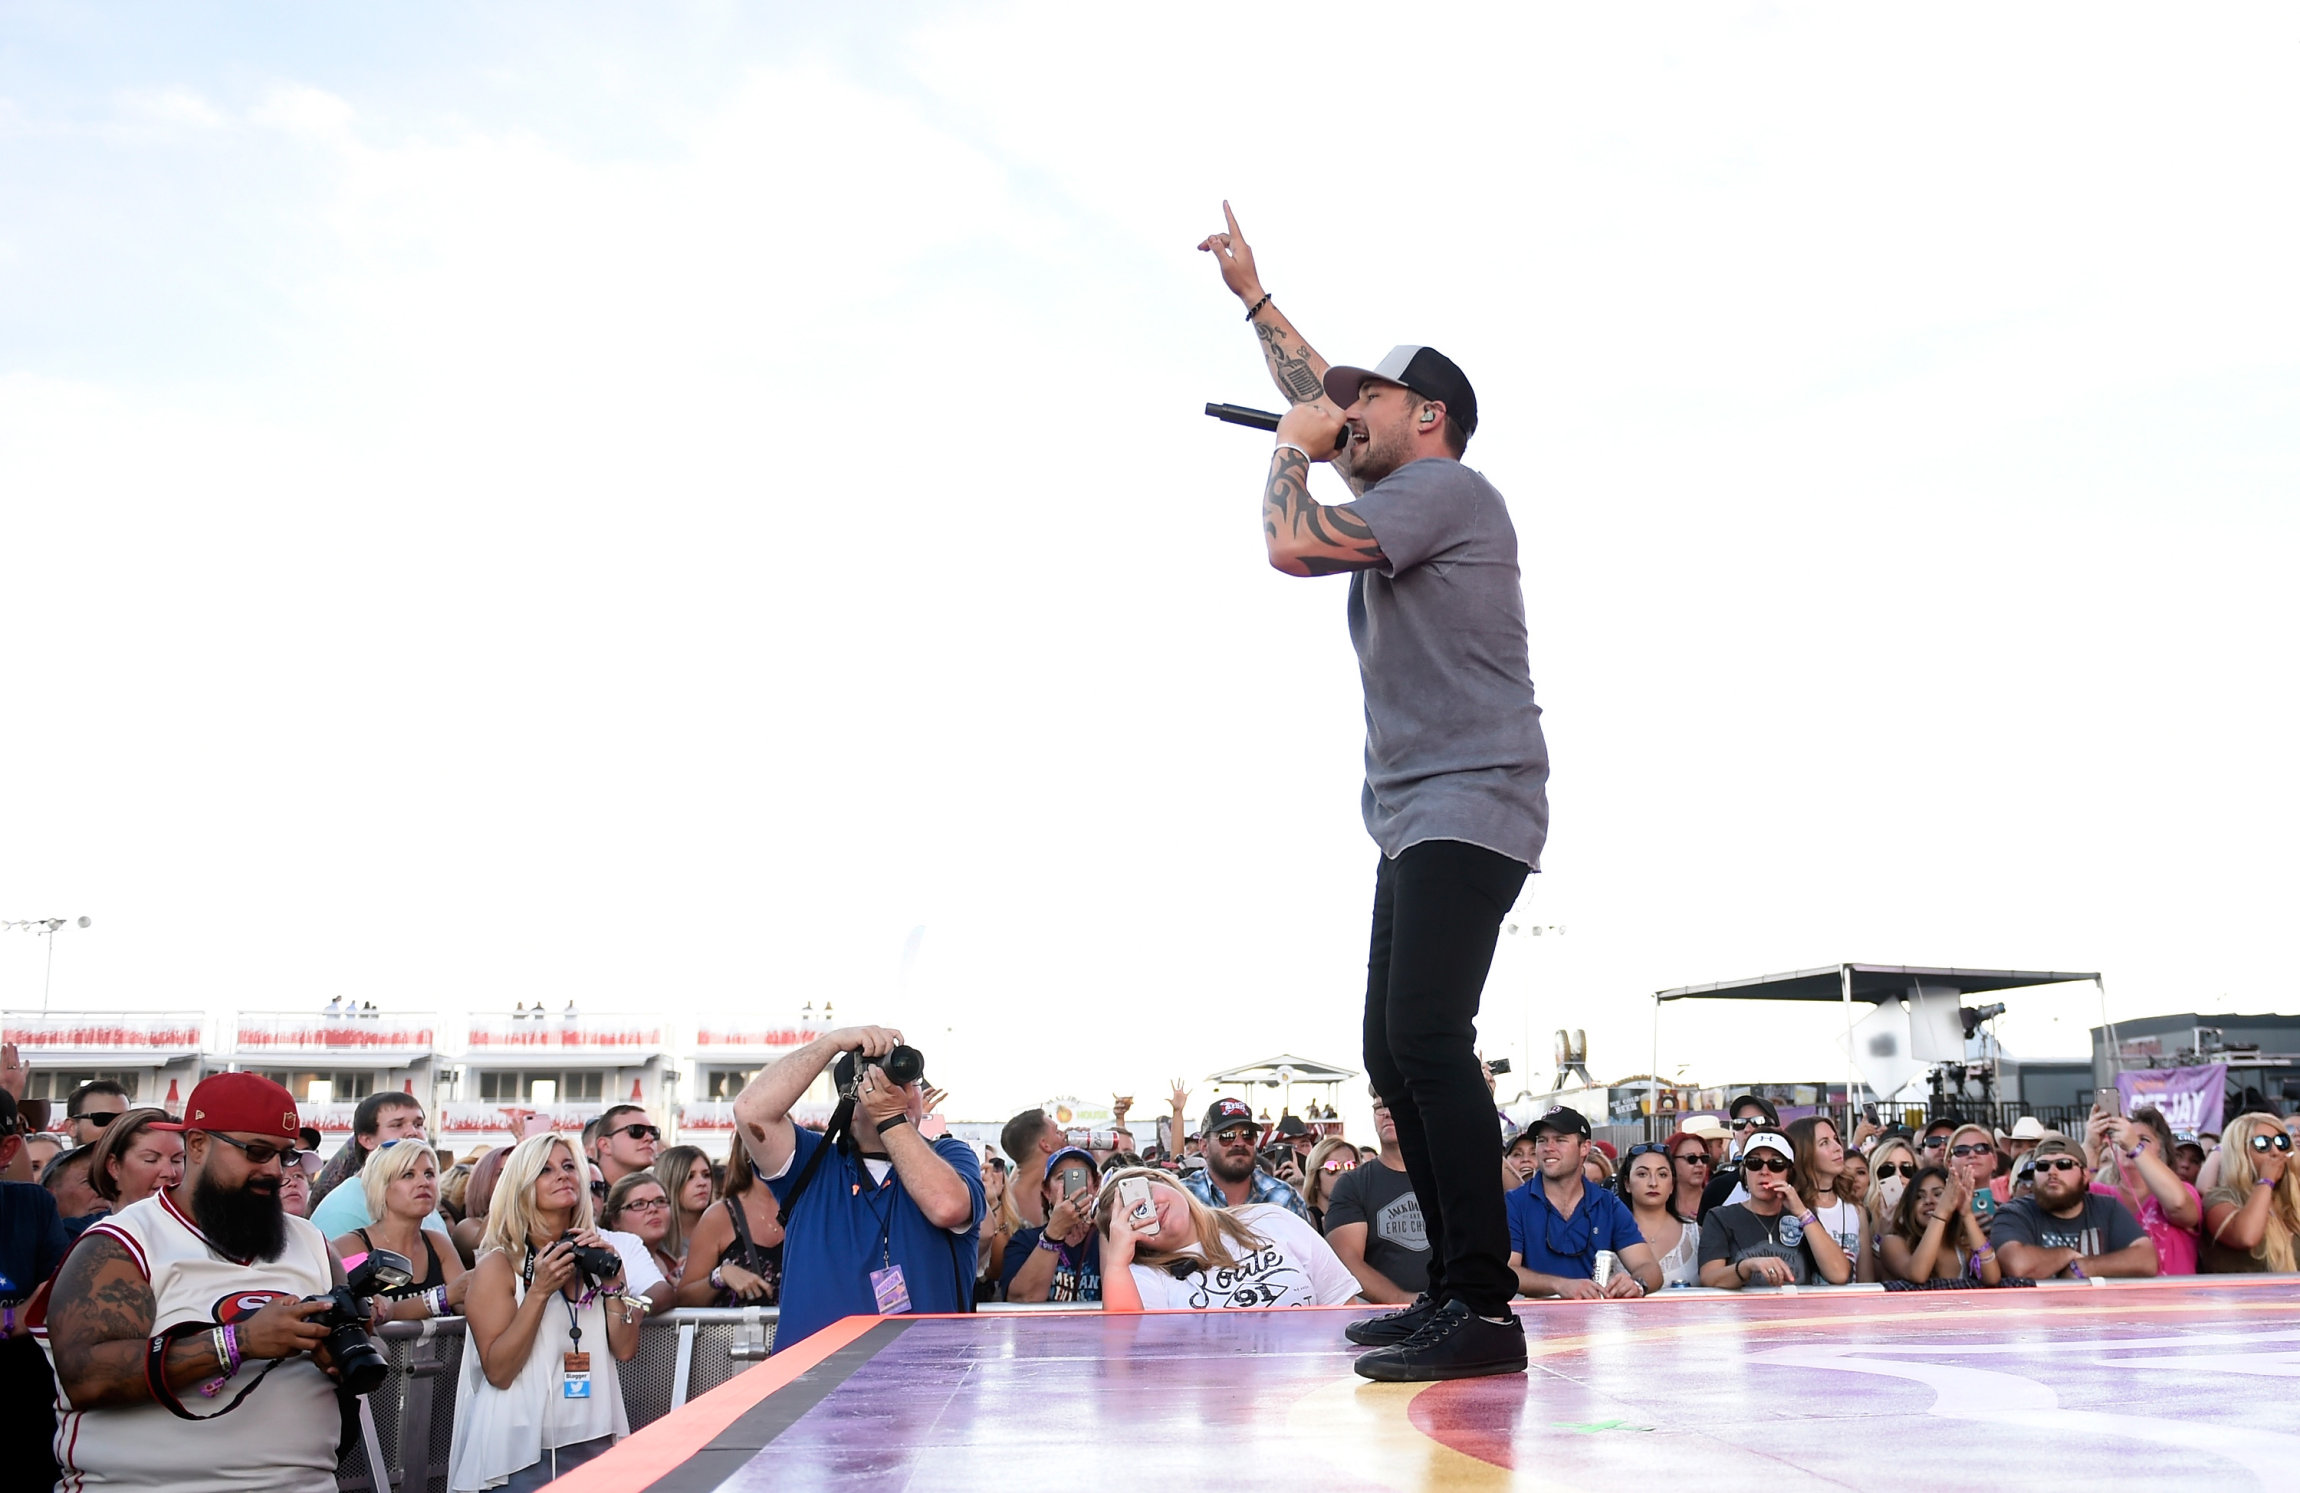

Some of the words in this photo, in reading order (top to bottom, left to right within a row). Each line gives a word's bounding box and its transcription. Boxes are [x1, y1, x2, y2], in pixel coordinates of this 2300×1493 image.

[1622, 1096, 1639, 1105] COLD
[1077, 1111, 1108, 1120] HOUSE
[1616, 1103, 1638, 1114] BEER
[1387, 1203, 1408, 1219] JACK
[1386, 1221, 1407, 1234] ERIC
[525, 1253, 534, 1279] SONY
[1189, 1245, 1284, 1309] Route
[1234, 1283, 1277, 1307] 91
